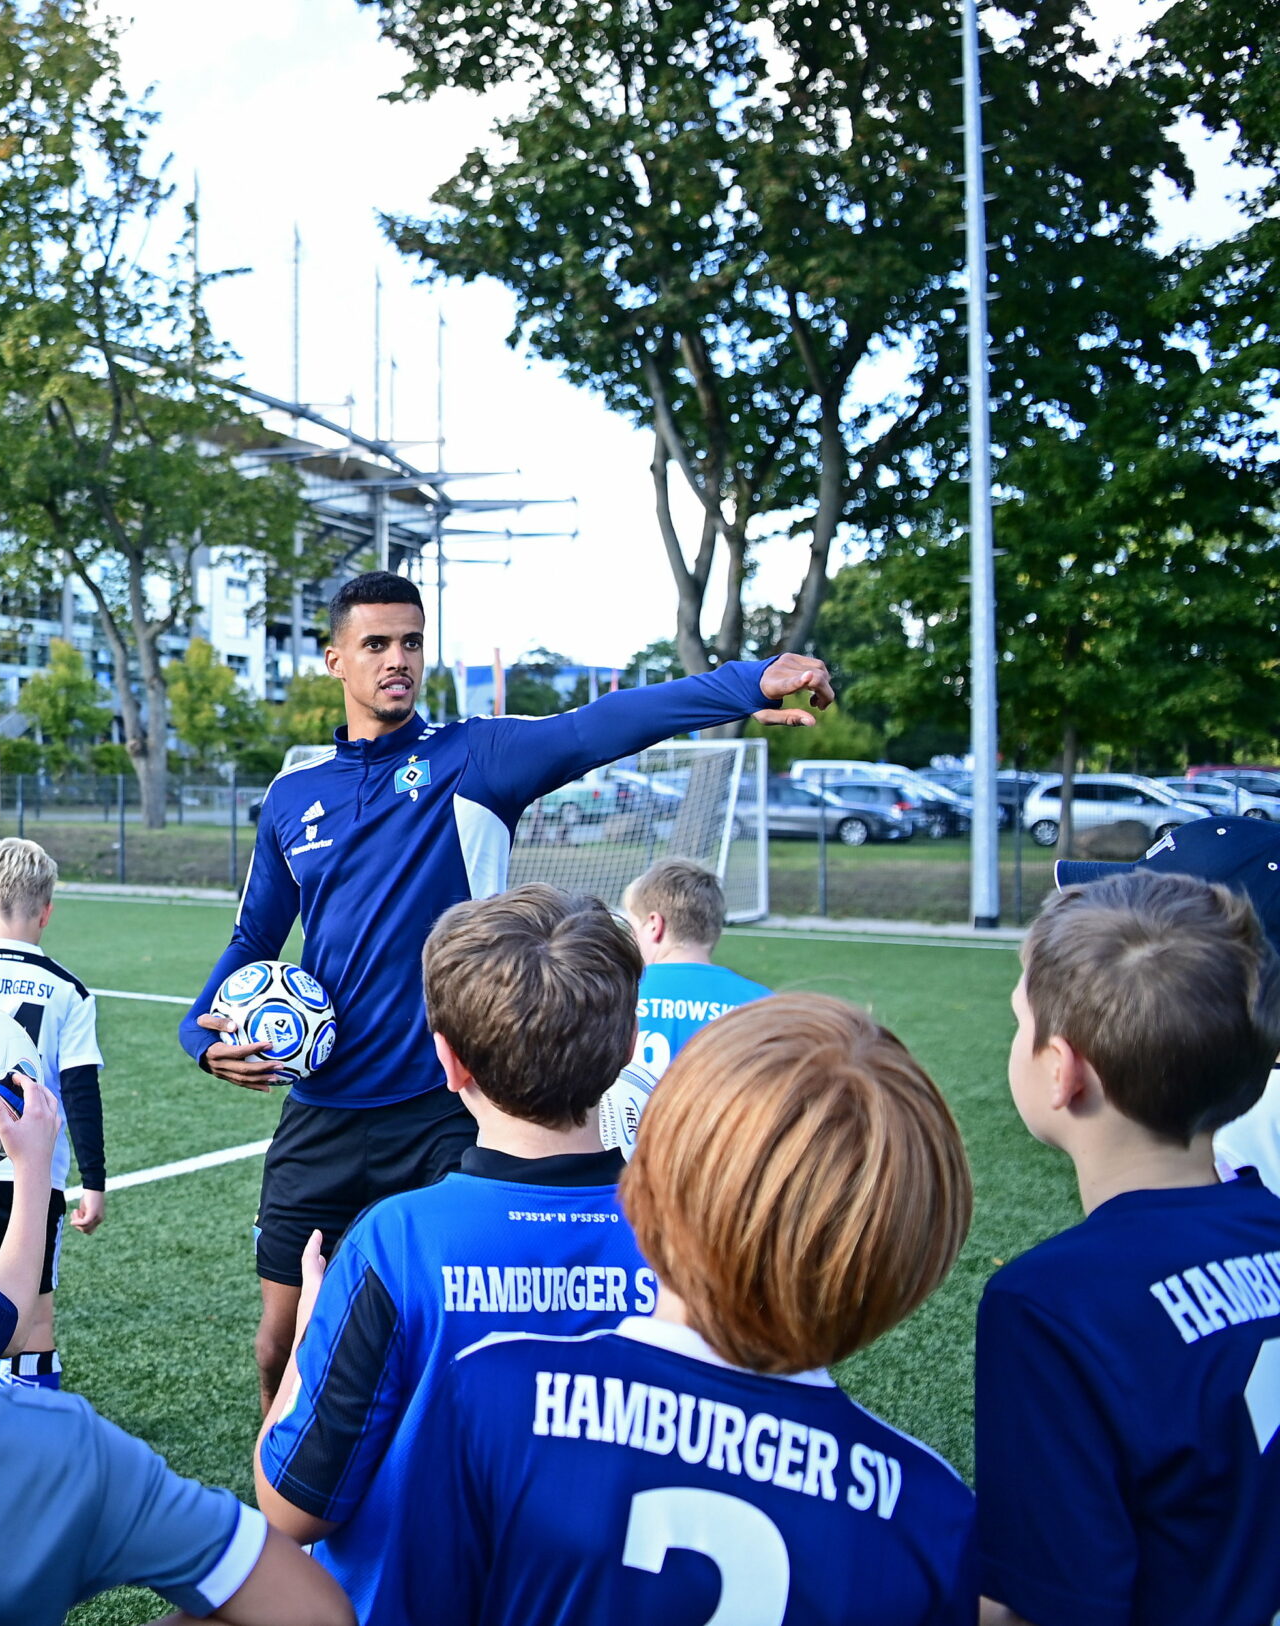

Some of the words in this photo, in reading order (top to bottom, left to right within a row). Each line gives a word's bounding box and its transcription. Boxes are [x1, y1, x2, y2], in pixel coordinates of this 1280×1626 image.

[409, 789, 419, 802] 9
[37, 983, 55, 999] SV
[635, 998, 738, 1021] STROWSK
[625, 1107, 638, 1133] HEK
[557, 1213, 566, 1222] N
[610, 1213, 619, 1223] O
[441, 1265, 628, 1313] HAMBURGER
[634, 1267, 657, 1313] S
[1149, 1250, 1280, 1344] HAMBU
[532, 1370, 840, 1502] HAMBURGER
[846, 1442, 902, 1520] SV
